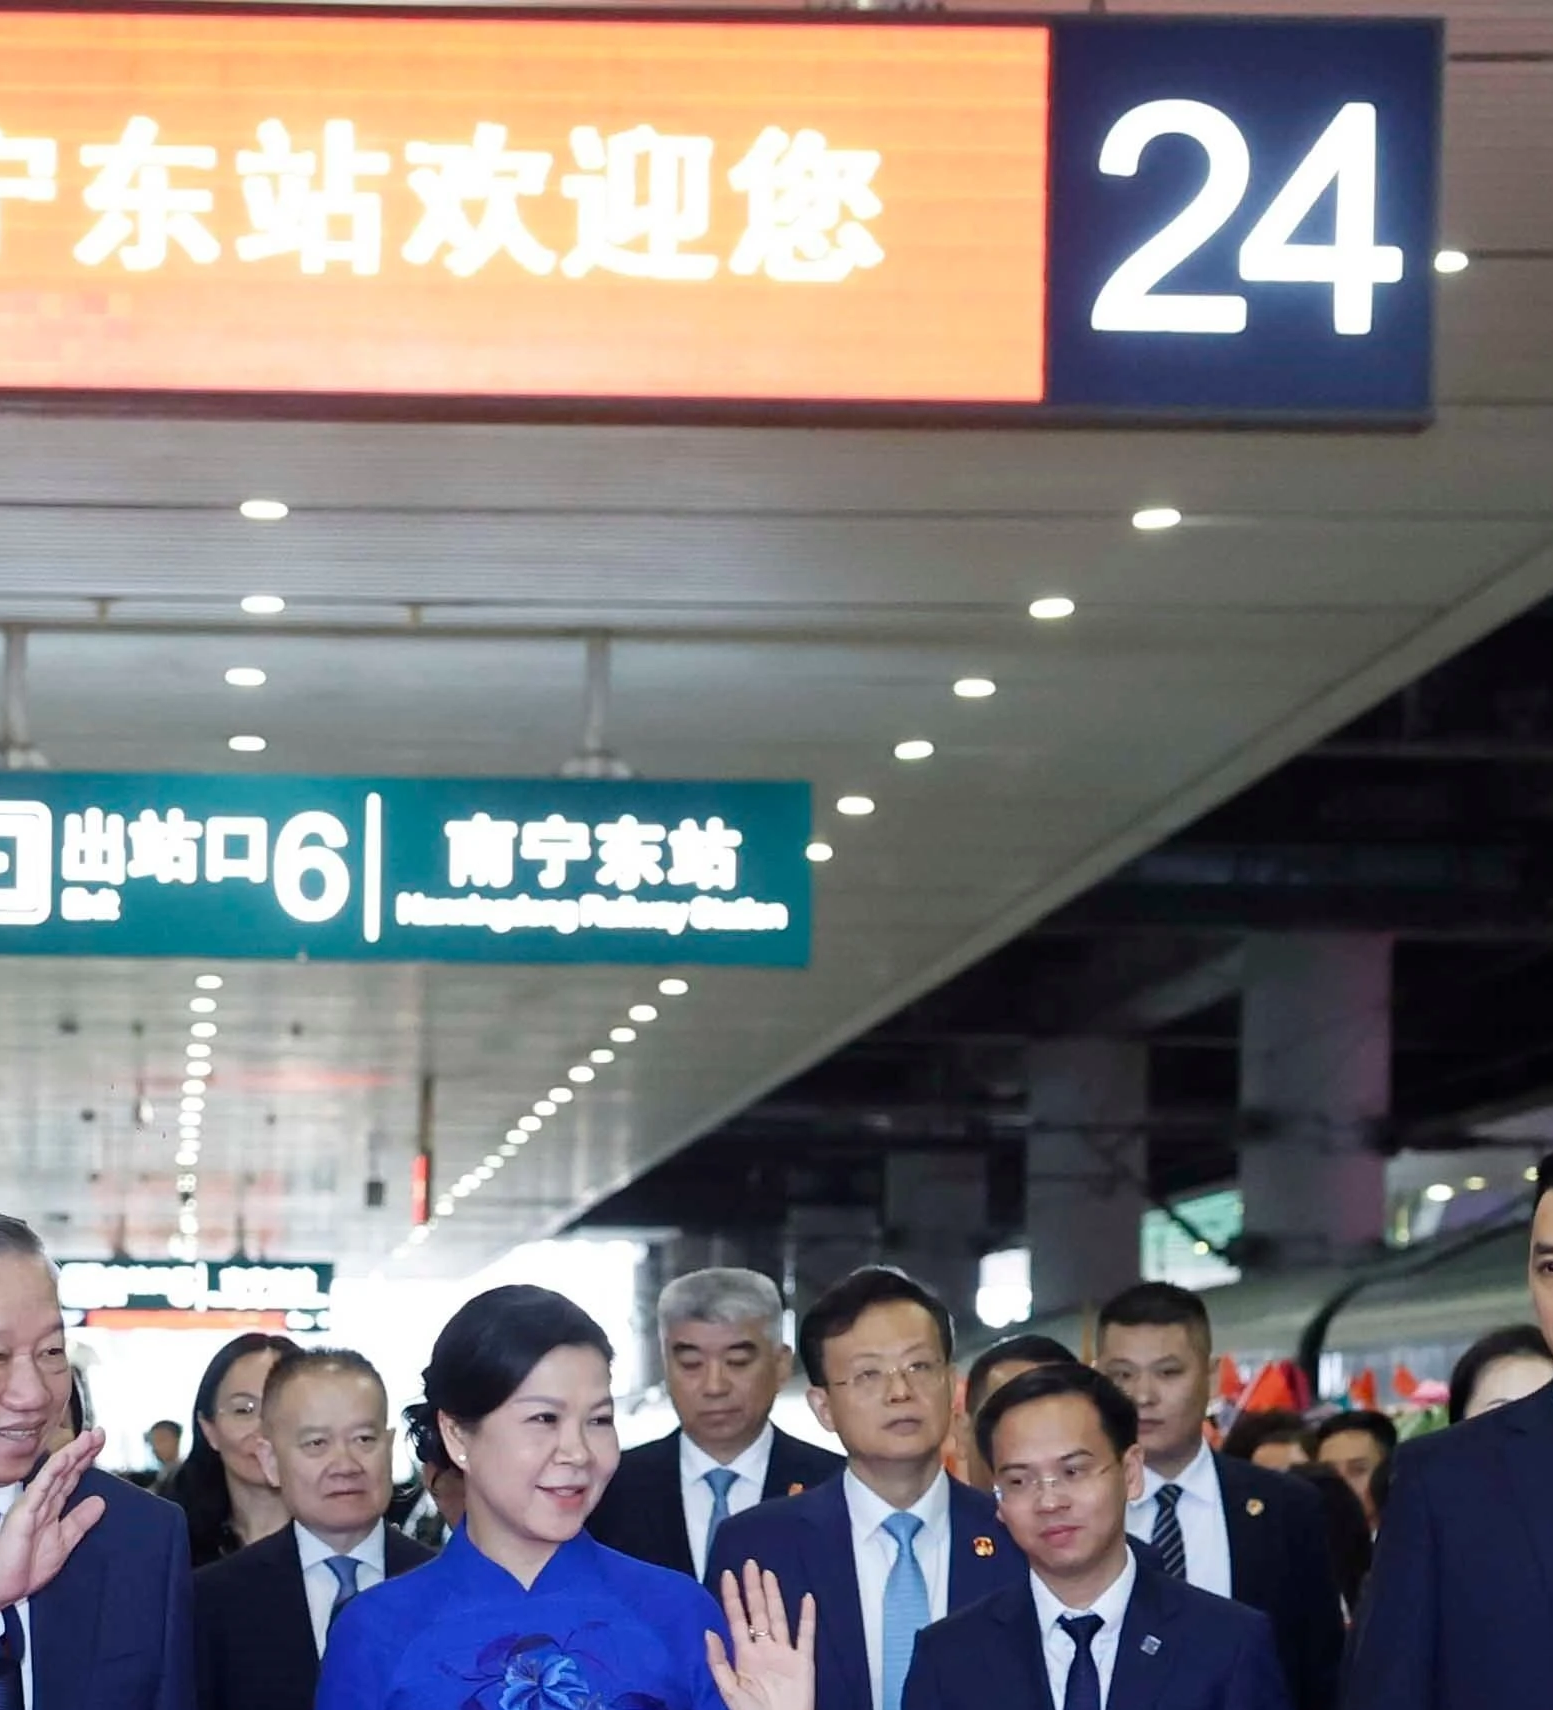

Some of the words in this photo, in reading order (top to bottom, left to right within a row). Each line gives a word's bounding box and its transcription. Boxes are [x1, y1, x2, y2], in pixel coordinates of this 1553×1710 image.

[1090, 98, 1404, 336] 24
[60, 806, 268, 885] 出站口
[272, 810, 351, 923] 6
[443, 811, 743, 892] 南宁东站
